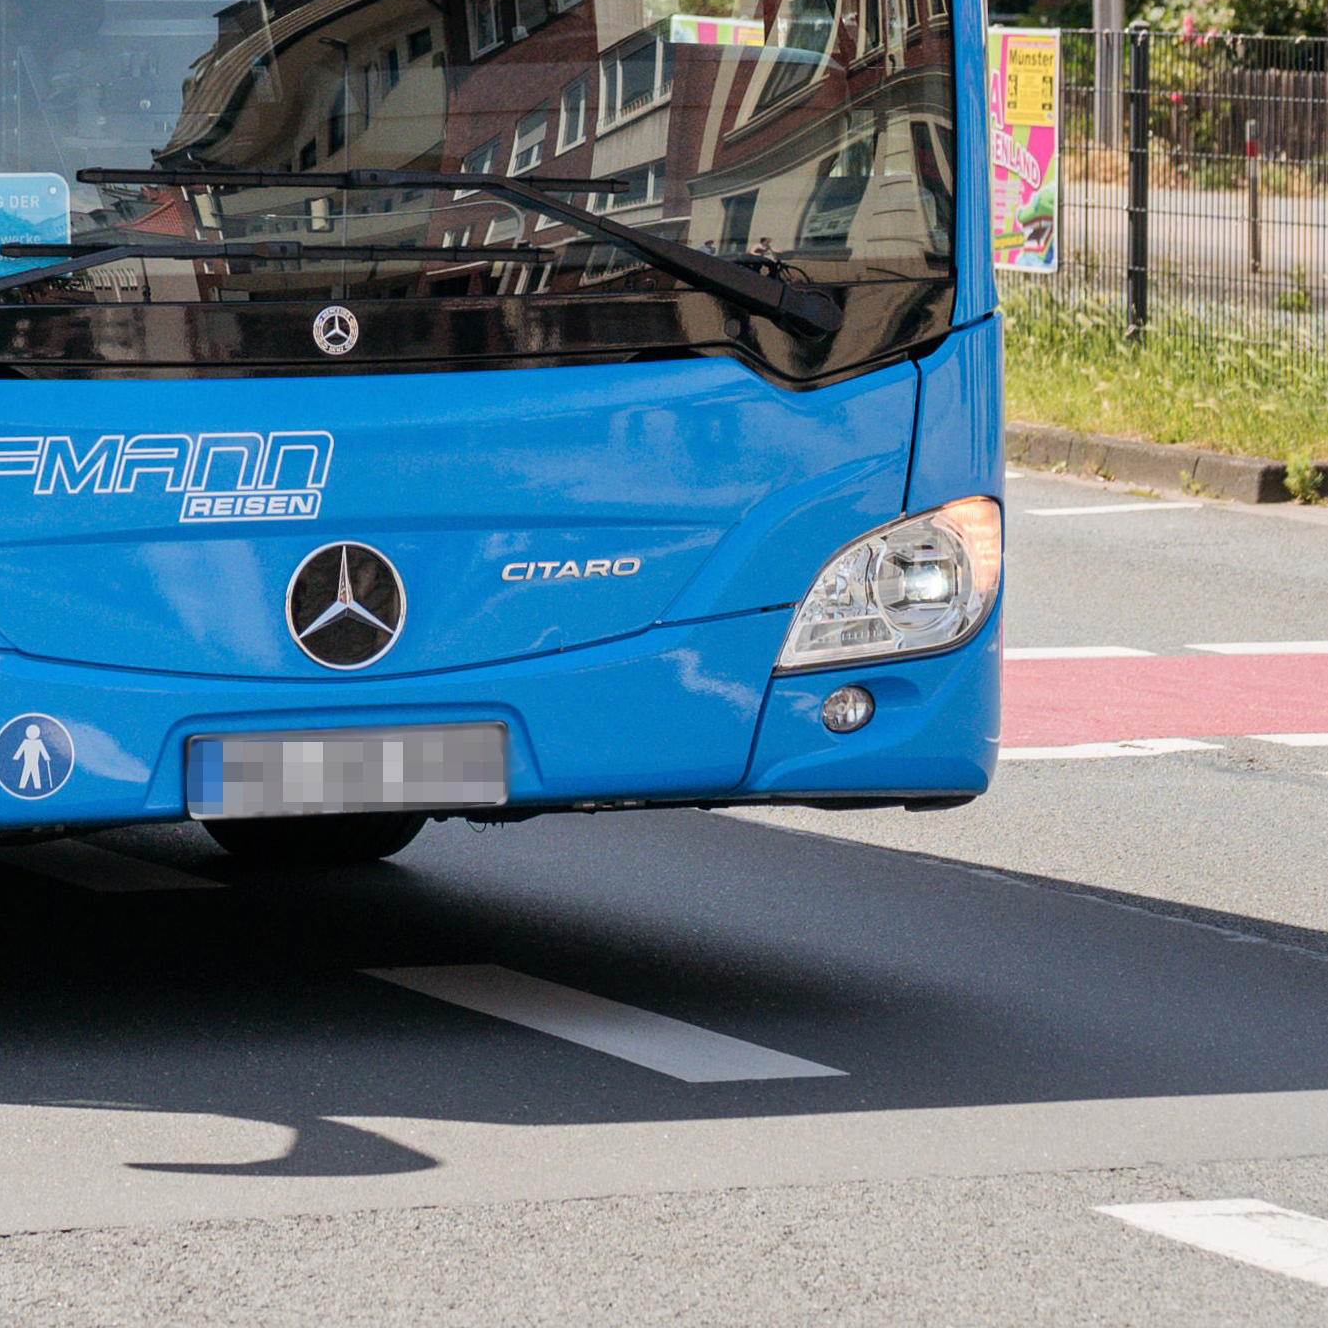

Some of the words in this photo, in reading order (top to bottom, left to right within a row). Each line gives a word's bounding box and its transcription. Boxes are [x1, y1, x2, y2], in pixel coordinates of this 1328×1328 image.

[992, 131, 1041, 191] ENLAND
[10, 195, 40, 209] DER
[187, 494, 317, 517] REISEN
[501, 557, 641, 582] CITARO
